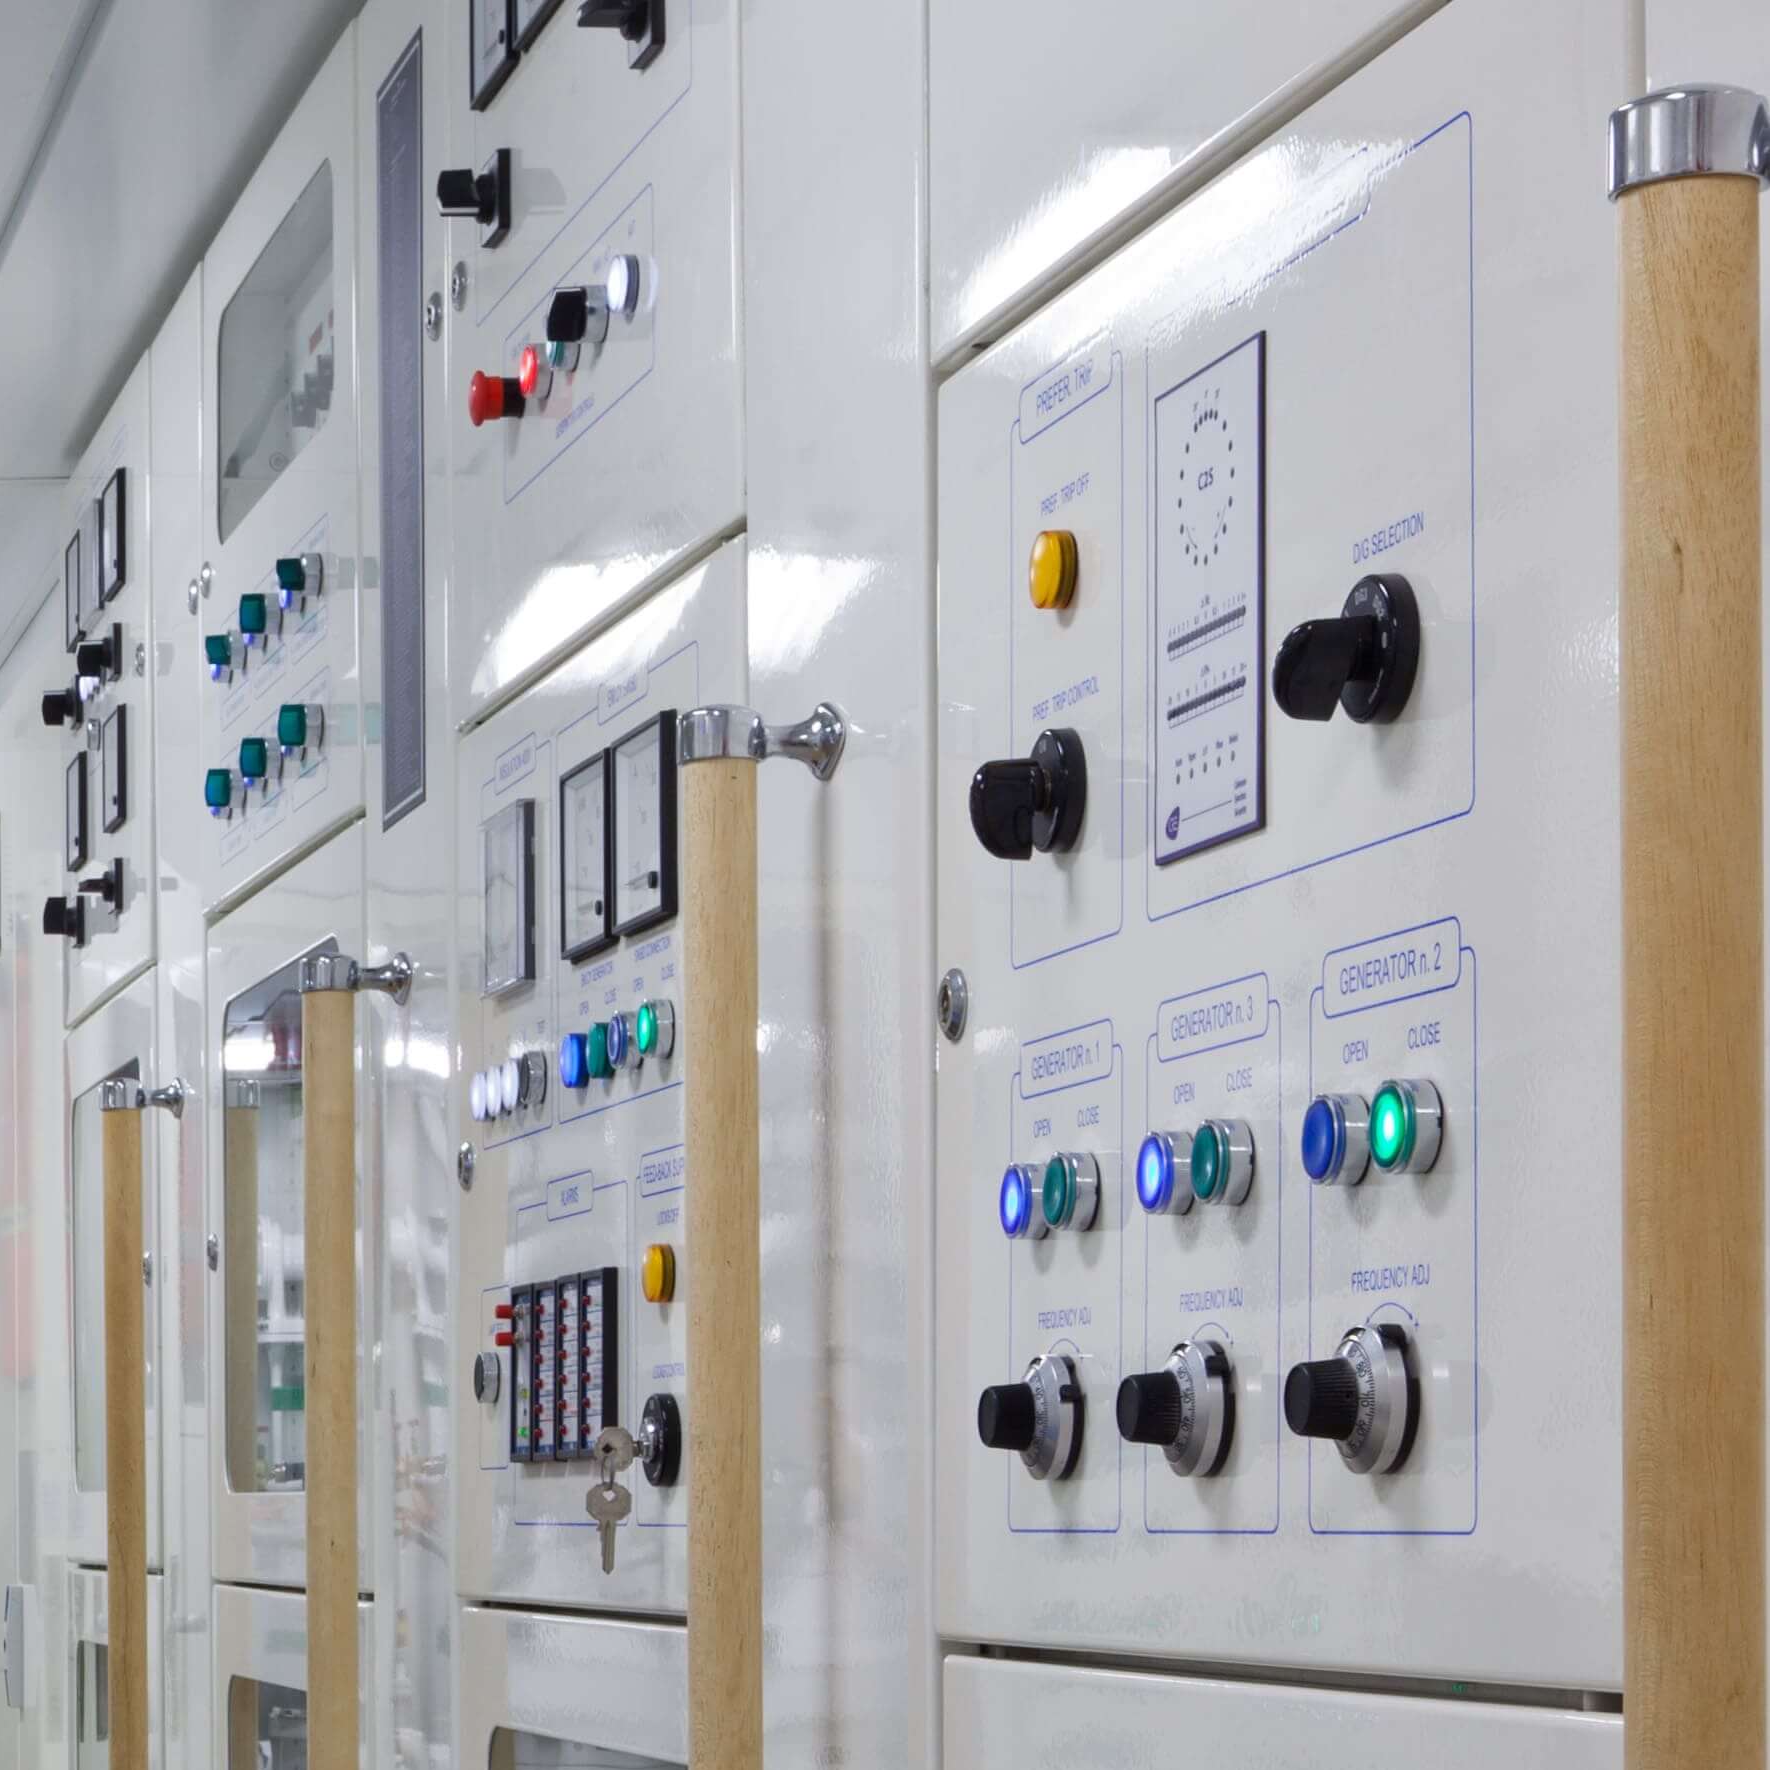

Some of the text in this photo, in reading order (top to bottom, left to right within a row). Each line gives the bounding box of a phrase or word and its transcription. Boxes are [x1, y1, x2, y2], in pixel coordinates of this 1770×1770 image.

[1074, 359, 1093, 391] TRIP
[1076, 472, 1090, 496] OFF
[1353, 511, 1425, 564] D/G SELECTION
[1068, 676, 1100, 706] CONTROL
[1340, 942, 1441, 995] GENERATOR n. 2
[1171, 994, 1253, 1042] GENERATOR n. 3
[1342, 1022, 1441, 1064] OPEN CLOSE
[1032, 1044, 1083, 1080] GENERATOR
[1095, 1040, 1100, 1063] 1
[1174, 1067, 1252, 1104] OPEN CLOSE
[1033, 1105, 1100, 1138] OPEN CLOSE
[1350, 1264, 1431, 1293] FREQUENCY ADJ
[1179, 1287, 1244, 1312] FREQUENCY ADJ
[1038, 1306, 1092, 1331] FREQUENCY ADJ
